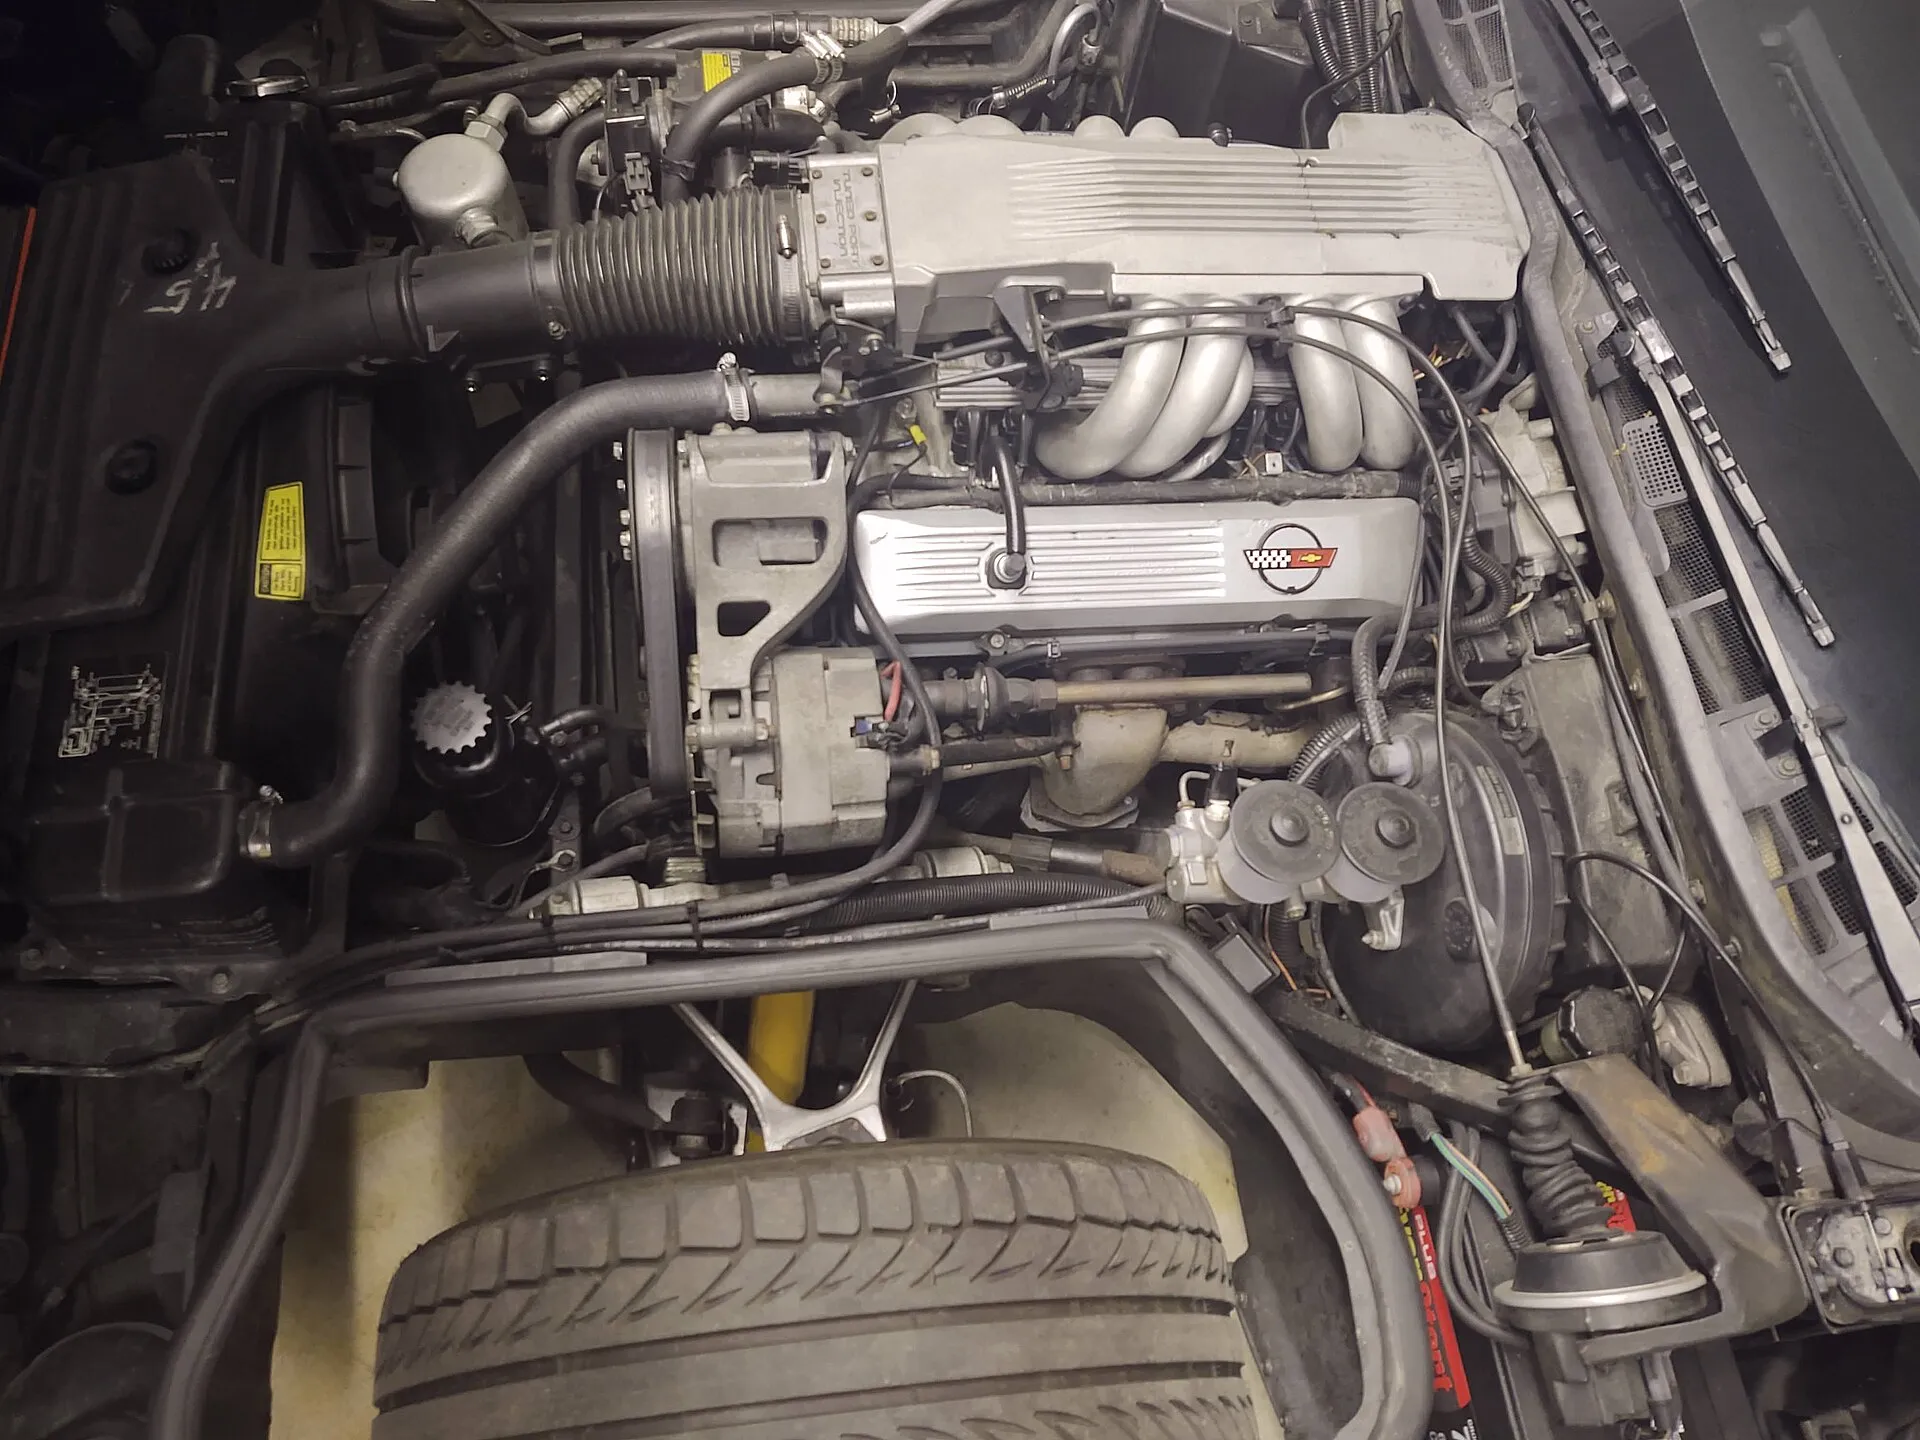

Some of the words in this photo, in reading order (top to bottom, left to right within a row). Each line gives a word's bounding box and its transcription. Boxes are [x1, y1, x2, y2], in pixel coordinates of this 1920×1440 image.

[832, 178, 848, 257] INJECTION
[843, 168, 855, 220] TUNED
[1415, 1214, 1437, 1280] PLUS
